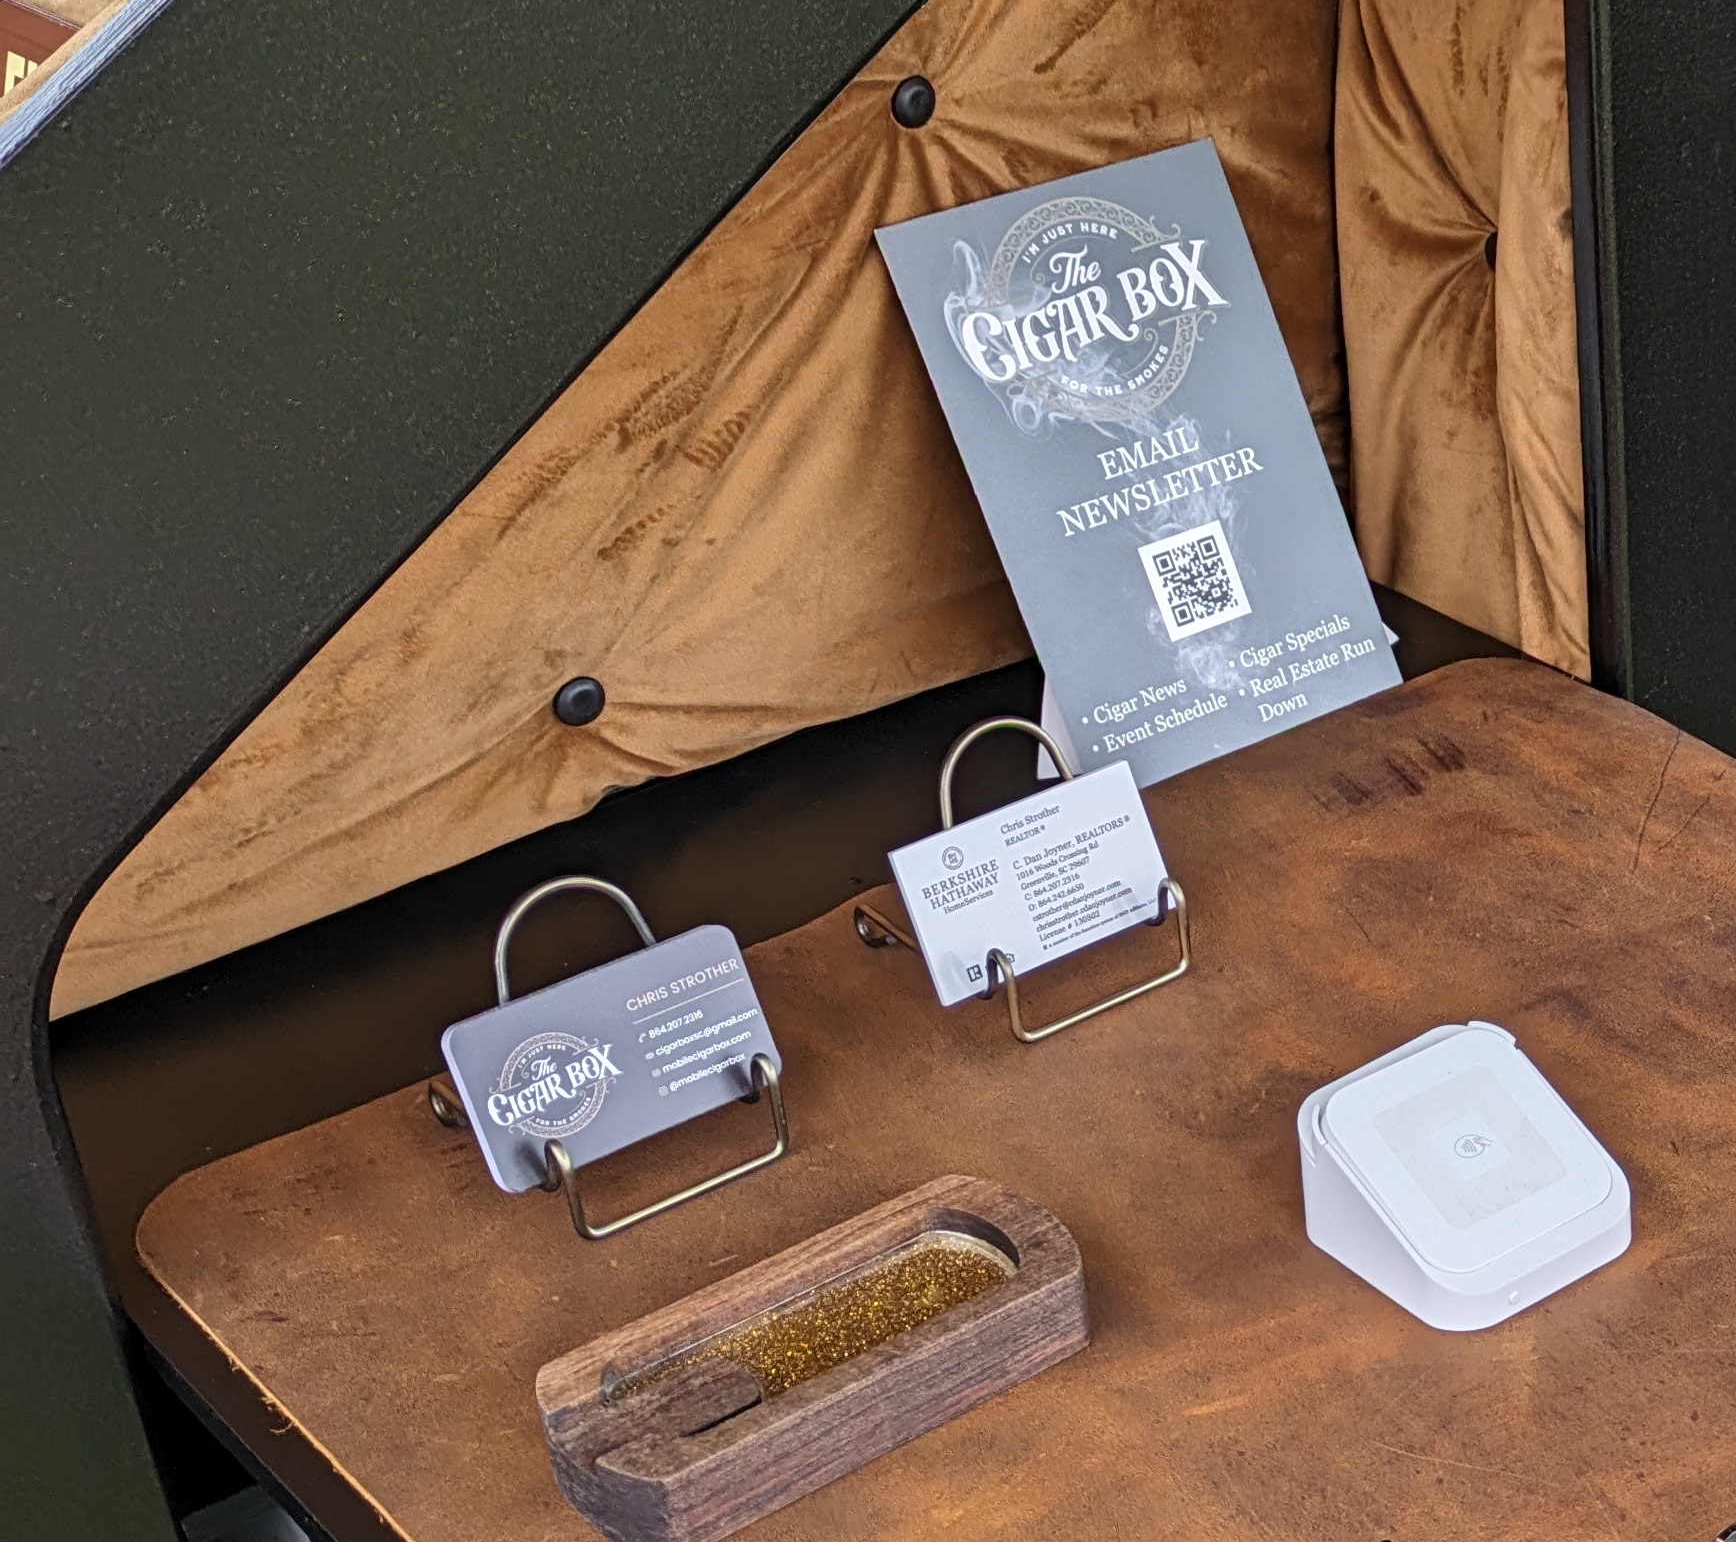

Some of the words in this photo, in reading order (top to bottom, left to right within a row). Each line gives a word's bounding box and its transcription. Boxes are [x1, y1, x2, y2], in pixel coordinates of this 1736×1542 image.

[1022, 243, 1040, 264] I'M
[1041, 223, 1075, 245] JUST
[1080, 221, 1119, 240] HERE
[1049, 243, 1102, 294] The
[961, 285, 1140, 381] CIGAR
[1116, 239, 1230, 322] BOX
[1060, 375, 1088, 395] FOR
[1095, 385, 1123, 397] THE
[1129, 344, 1169, 390] SMOKES
[1096, 426, 1200, 480] EMAIL
[1056, 447, 1264, 537] NEWSLETTER
[1240, 641, 1283, 669] Cigar
[1285, 613, 1351, 651] Specials
[1249, 668, 1289, 698] Real
[1289, 650, 1340, 683] Estate
[1340, 636, 1376, 662] Run
[1093, 697, 1138, 725] Cigar
[1139, 678, 1187, 709] News
[1102, 724, 1154, 753] Event
[1154, 692, 1229, 733] Schedule
[1258, 691, 1308, 723] Down
[1000, 819, 1024, 835] Chris
[1024, 805, 1060, 824] Strother
[1012, 860, 1023, 870] C.
[1024, 852, 1042, 866] Dan
[1043, 839, 1076, 860] Joyner,
[1016, 867, 1034, 881] 1016
[1035, 858, 1058, 874] Woods
[1088, 840, 1100, 852] Rd
[1058, 865, 1069, 876] SC
[921, 859, 999, 899] BERKSHIRE
[929, 872, 999, 910] HATHAWAY
[1033, 872, 1080, 898] 864.207.2316
[1037, 882, 1085, 908] 864.242.6650
[943, 889, 994, 915] HomeServices
[1039, 925, 1067, 942] License
[1073, 910, 1101, 928] 130502
[626, 986, 669, 1011] CHRIS
[669, 958, 739, 994] STROTHER
[648, 1009, 704, 1039] 864.207.2316
[655, 1008, 758, 1056] cigarboxsc@gmail.com
[530, 1055, 558, 1081] The
[662, 1030, 752, 1074] mobilecigarbox.com
[669, 1053, 747, 1092] @mobilecigarbox
[487, 1073, 577, 1126] CIGAR
[565, 1043, 624, 1088] BOX
